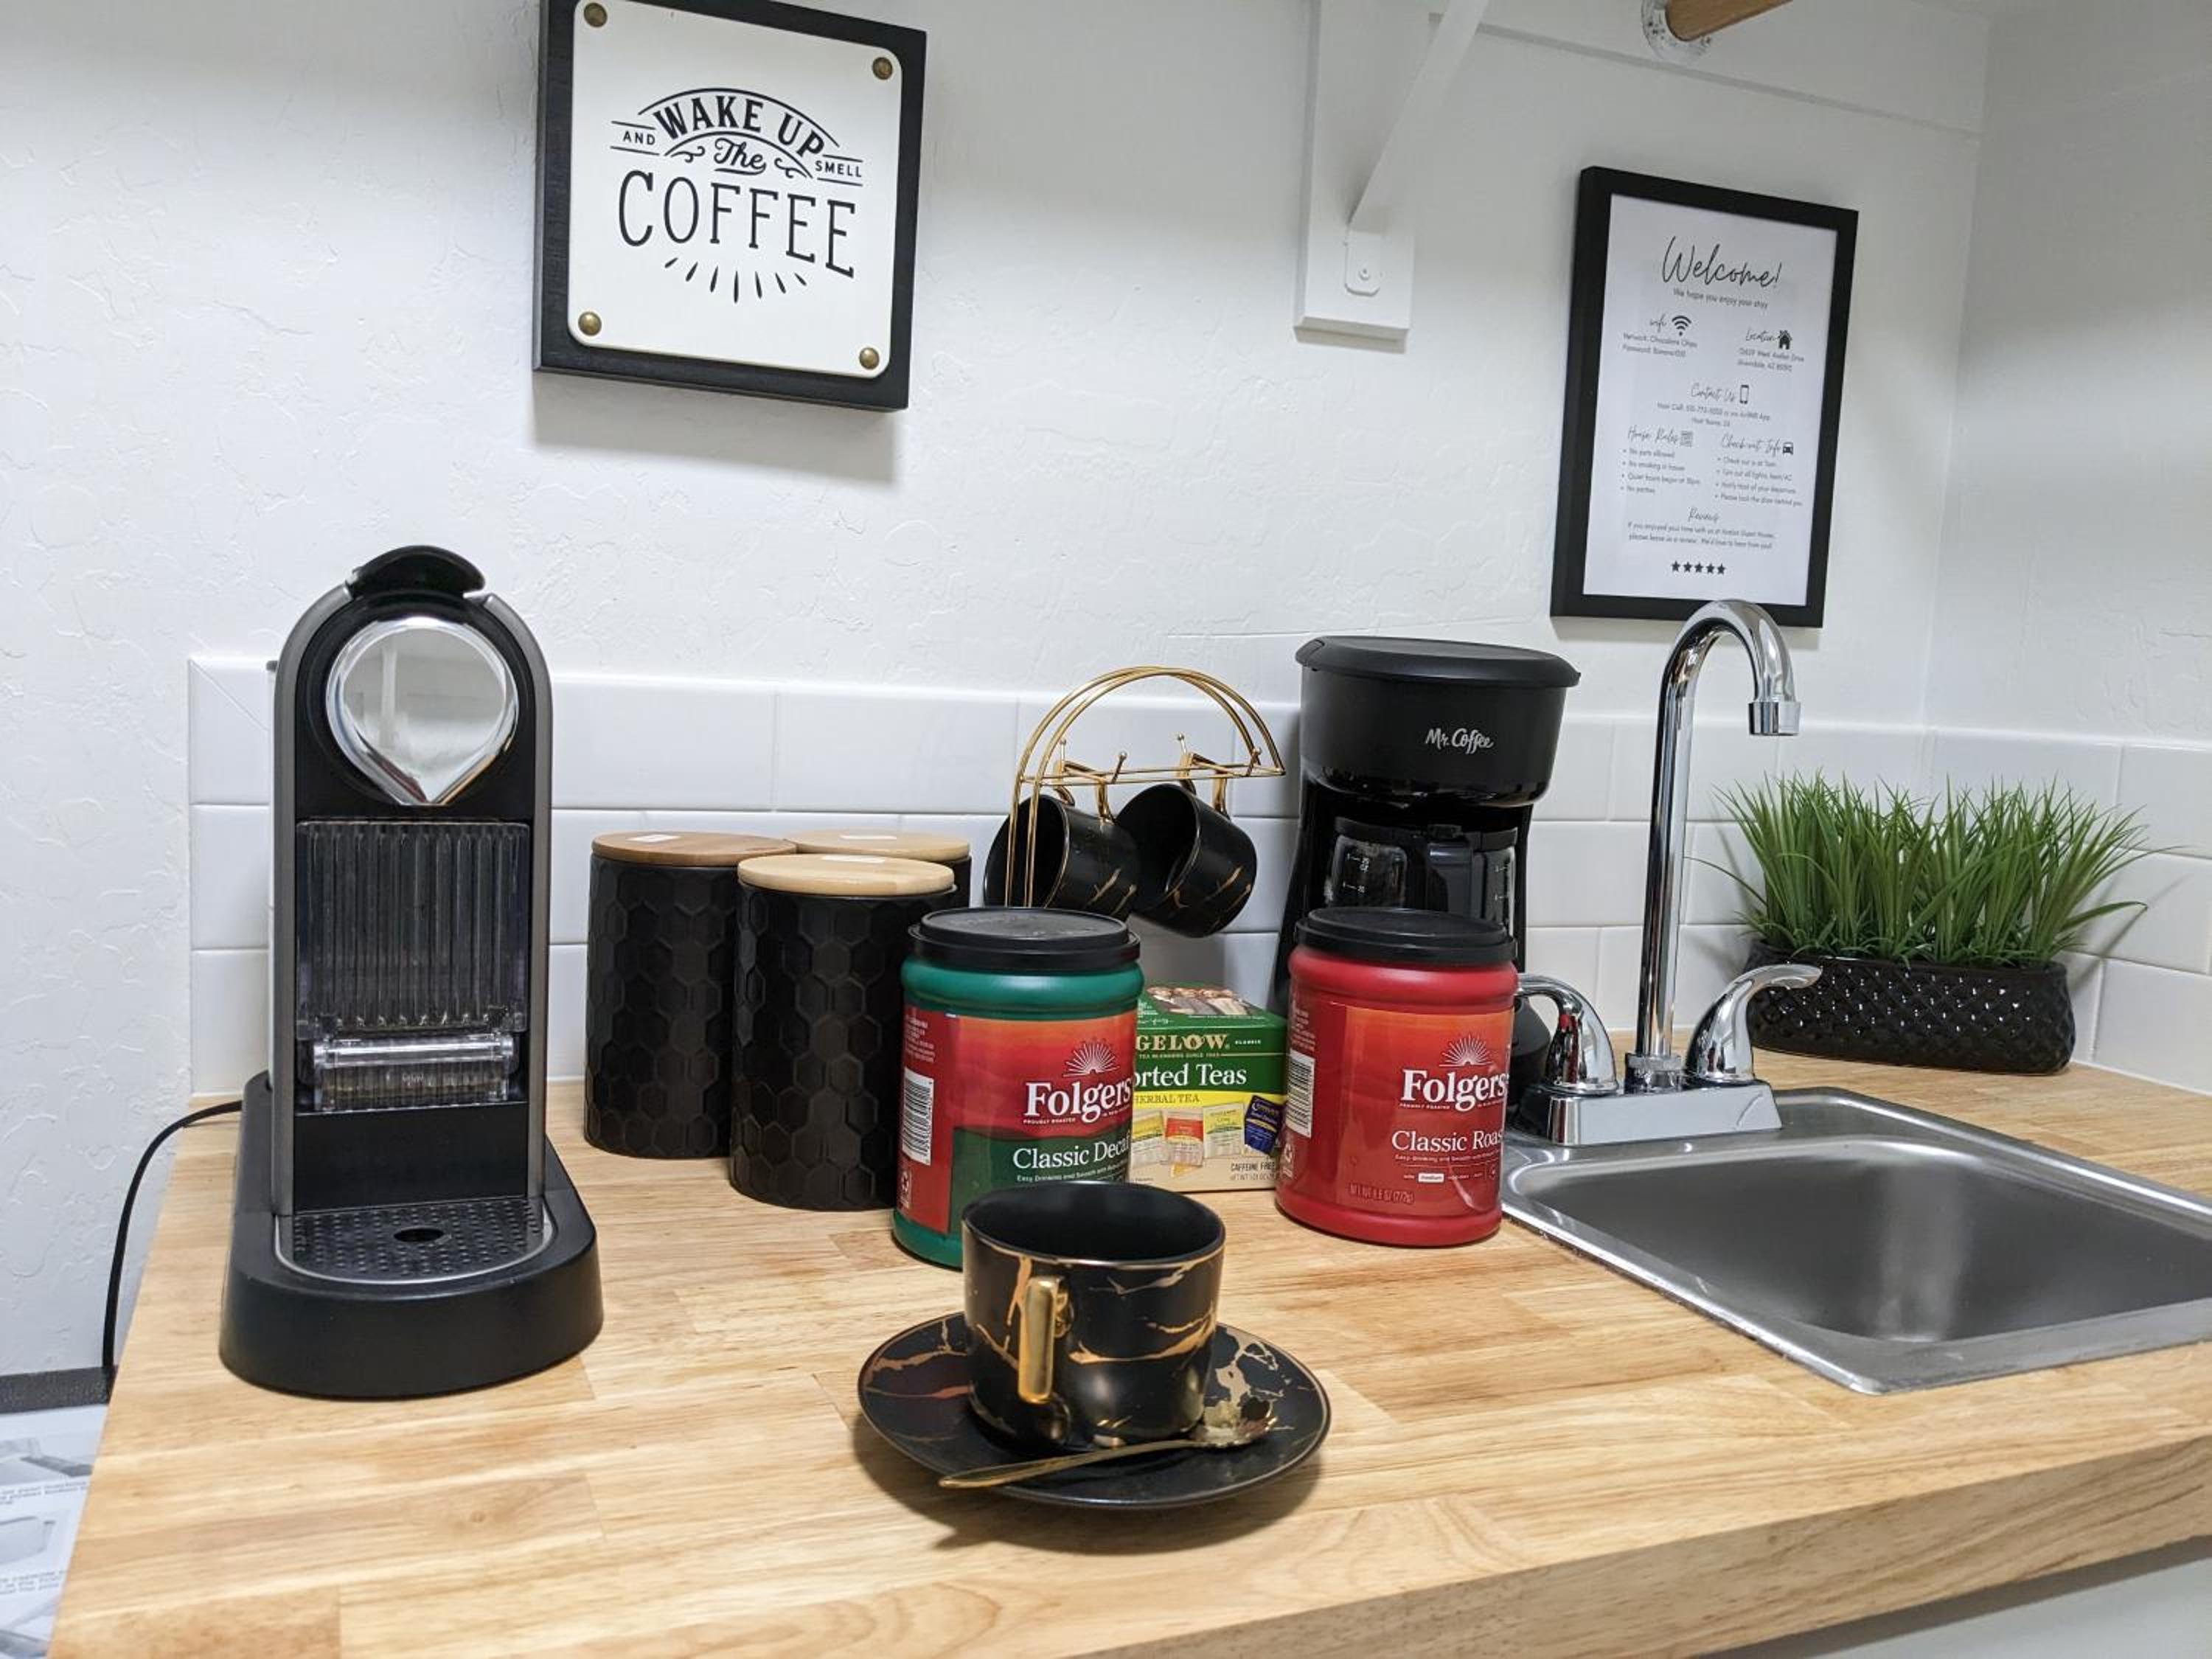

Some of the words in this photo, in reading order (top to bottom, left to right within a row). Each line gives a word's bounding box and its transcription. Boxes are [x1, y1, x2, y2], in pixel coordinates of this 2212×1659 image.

[623, 130, 656, 146] AND
[653, 94, 764, 140] WAKE
[778, 114, 824, 157] UP
[714, 137, 766, 175] The
[815, 159, 863, 178] SMELL
[619, 170, 856, 279] COFFEE
[1662, 235, 1783, 288] Welcome!
[1424, 728, 1450, 750] Mr.
[1451, 727, 1495, 755] Coffee
[1135, 1033, 1228, 1051] GELOW
[1134, 1062, 1190, 1087] orted
[1195, 1063, 1248, 1087] Teas
[1023, 1077, 1132, 1124] Folgers
[1178, 1093, 1201, 1104] TEA
[1400, 1068, 1507, 1112] Folgers
[1391, 1130, 1467, 1152] Classic
[1472, 1130, 1503, 1150] Roas
[1013, 1146, 1090, 1169] Classic
